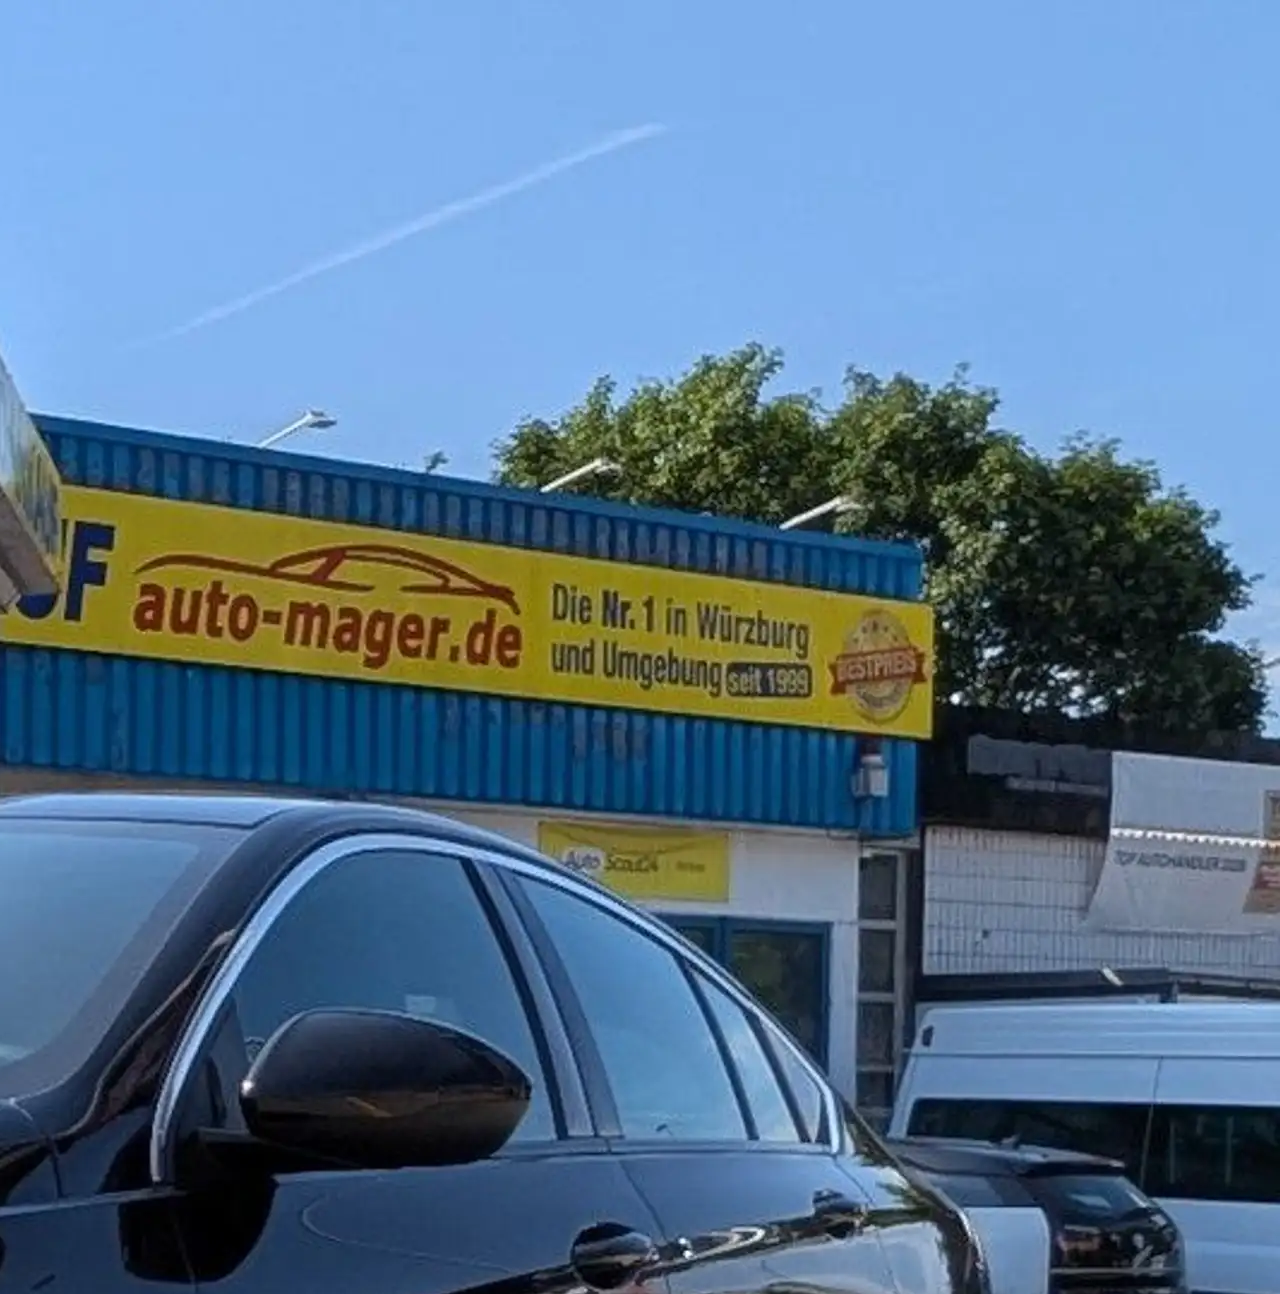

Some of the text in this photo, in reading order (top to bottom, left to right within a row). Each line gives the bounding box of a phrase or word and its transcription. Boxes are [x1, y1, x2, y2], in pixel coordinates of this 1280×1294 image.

[132, 579, 523, 669] auto-mager.de
[552, 583, 810, 660] Die Nr. 1 in Würzburg
[551, 638, 595, 675] und
[602, 640, 722, 698] Umgebung
[727, 665, 763, 694] seit
